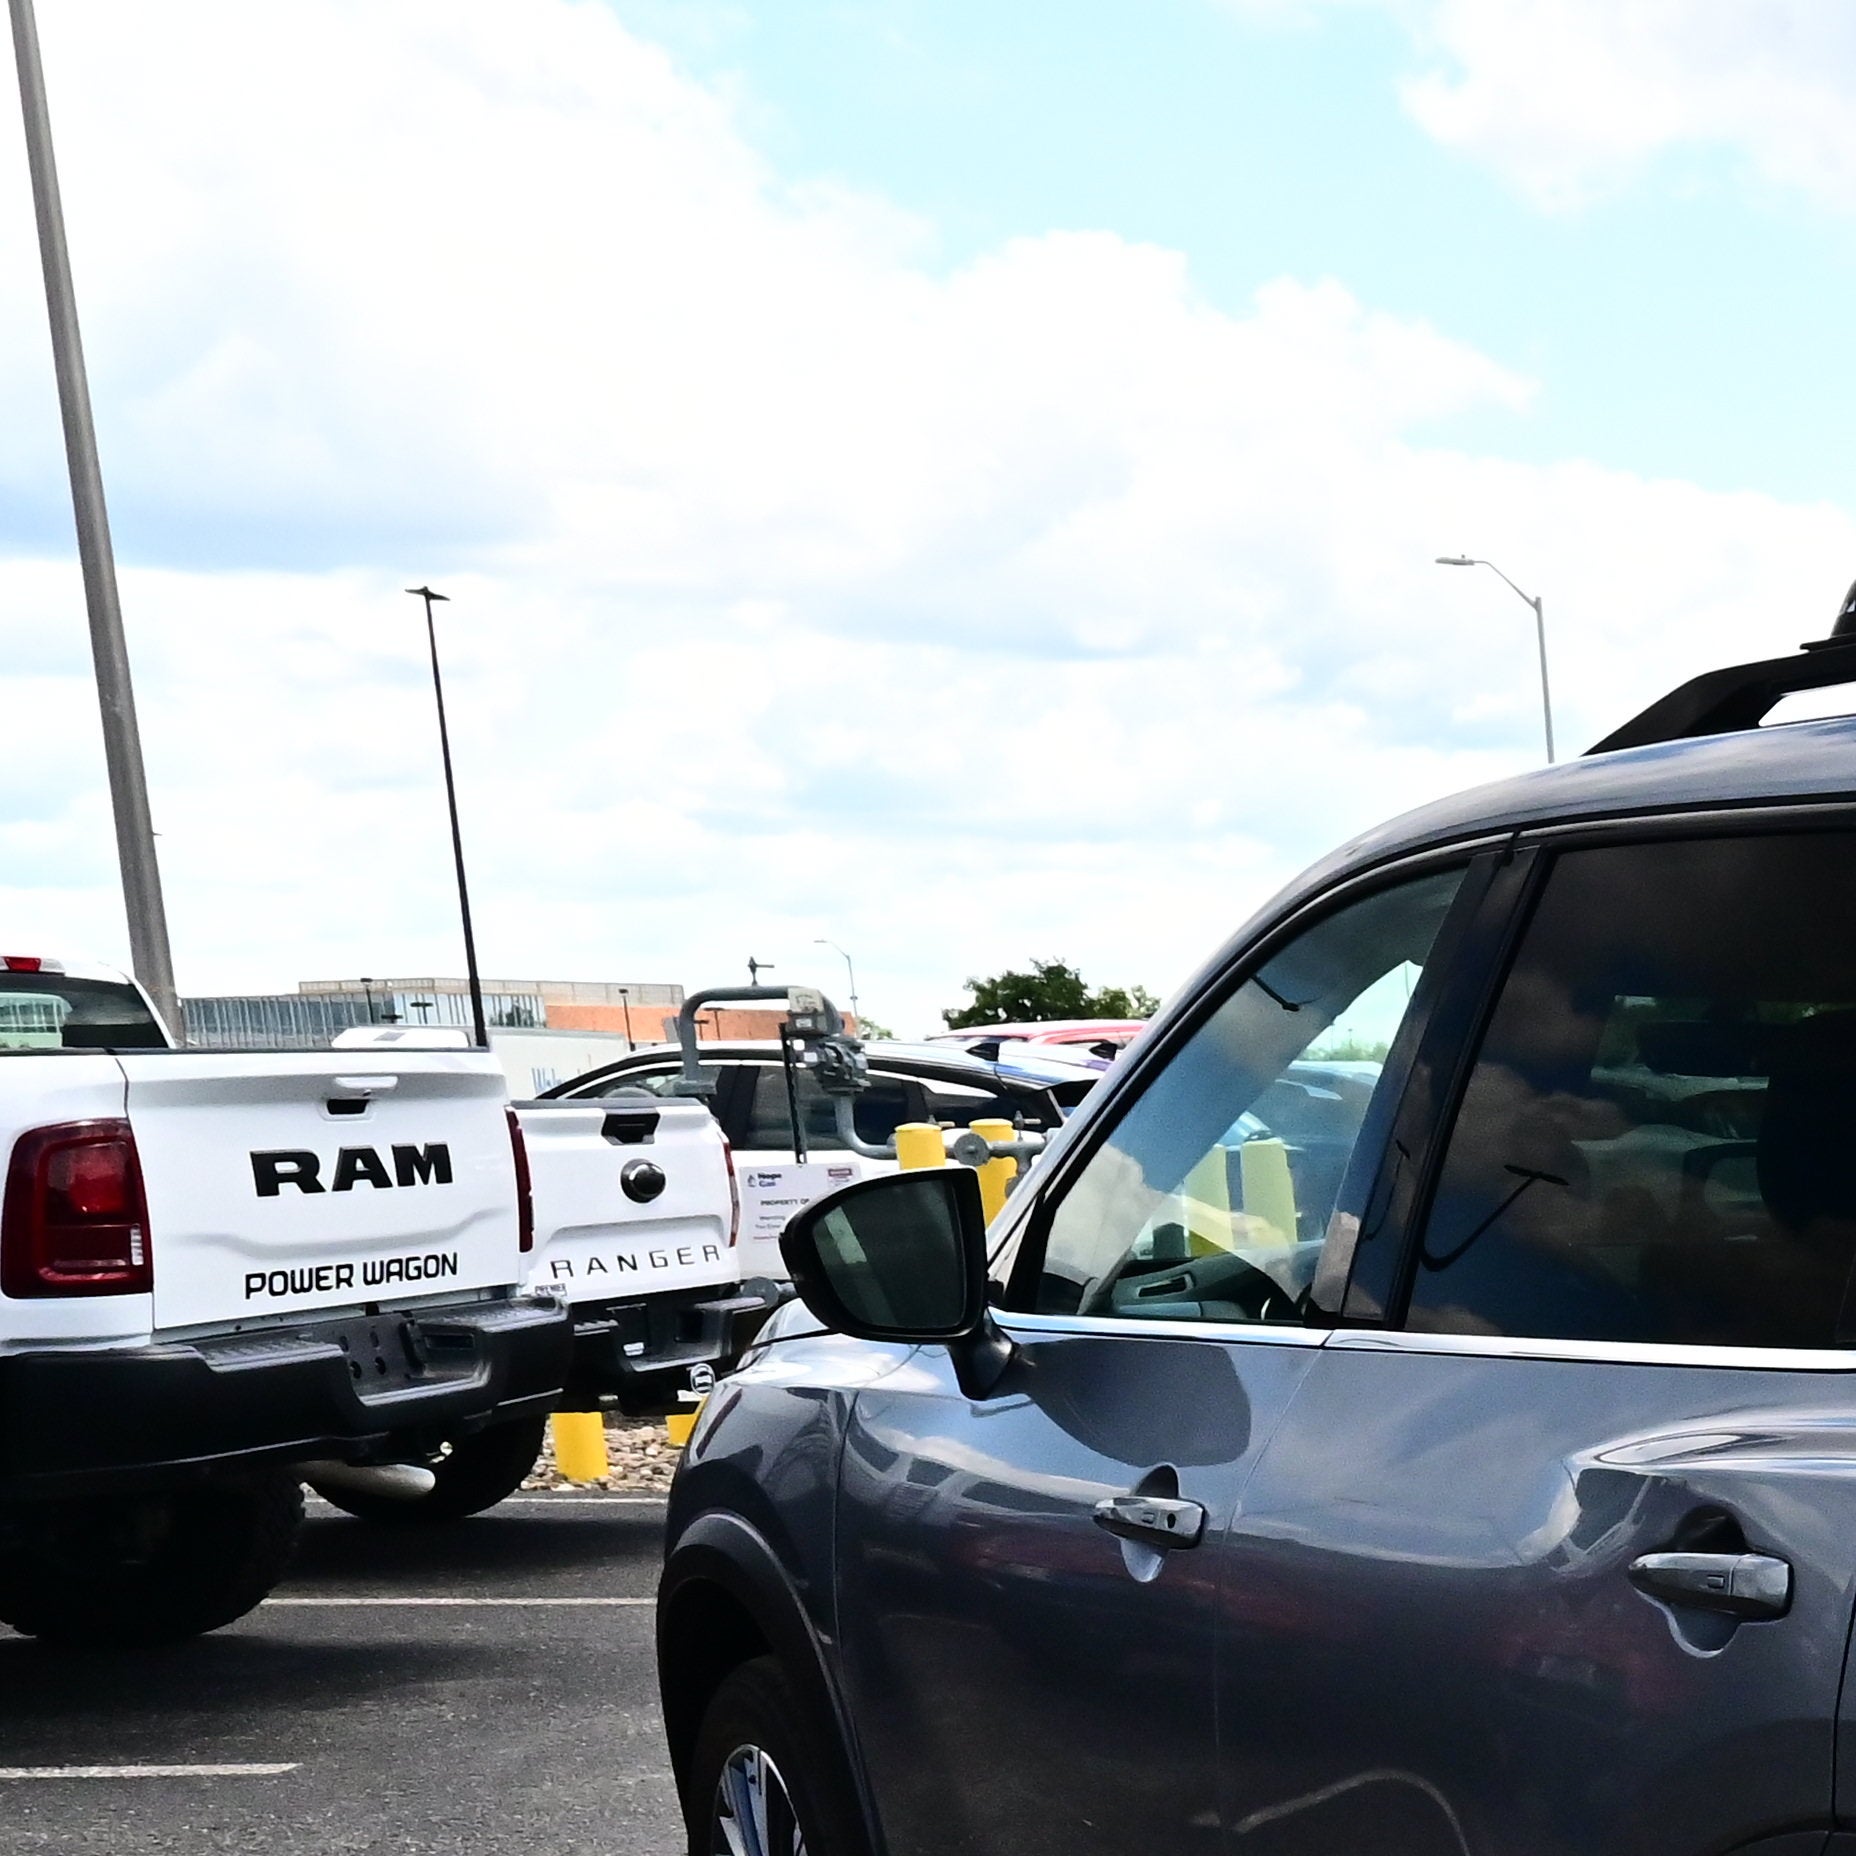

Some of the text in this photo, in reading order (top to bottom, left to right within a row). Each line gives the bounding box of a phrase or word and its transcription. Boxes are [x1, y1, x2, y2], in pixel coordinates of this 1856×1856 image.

[250, 1141, 453, 1197] RAM
[245, 1252, 457, 1299] POWER WAGON
[550, 1245, 720, 1279] RANGER
